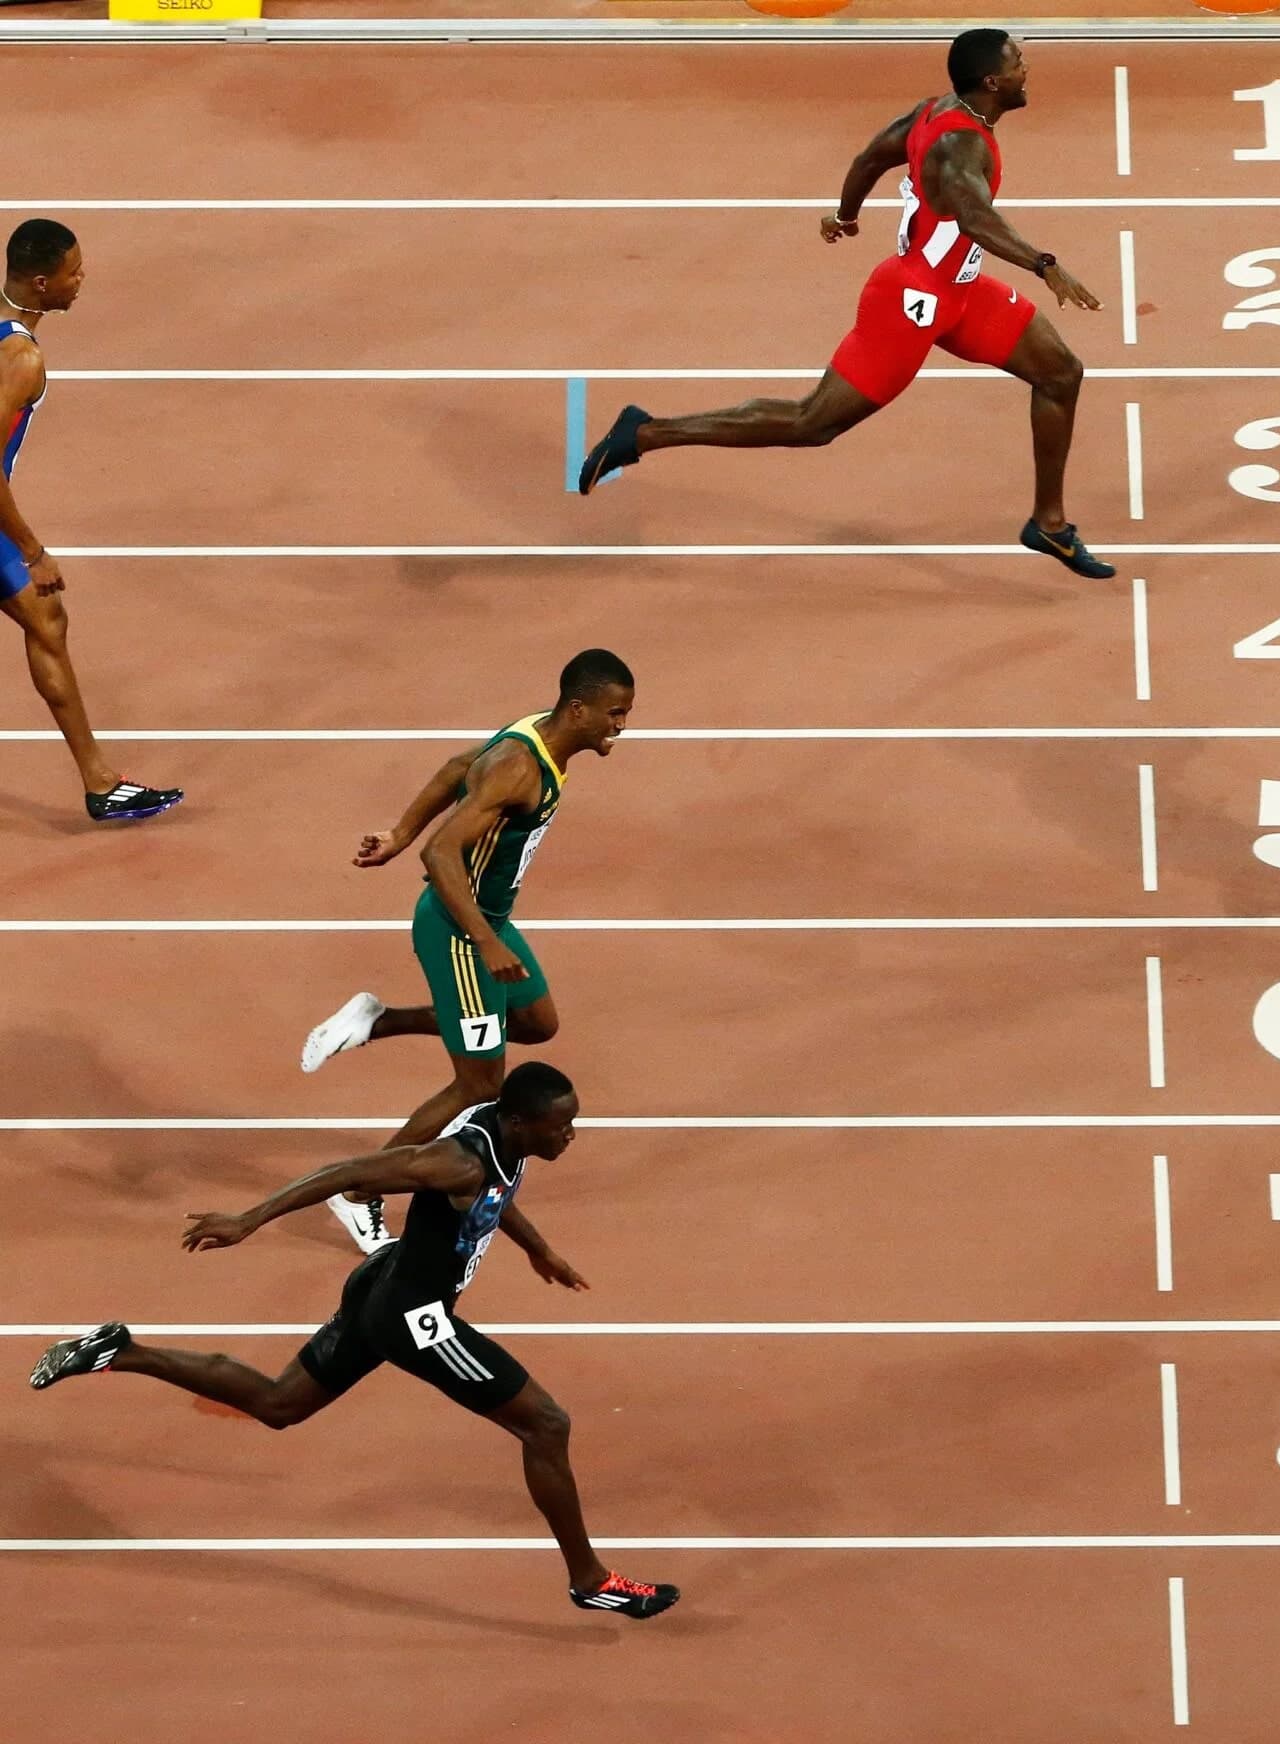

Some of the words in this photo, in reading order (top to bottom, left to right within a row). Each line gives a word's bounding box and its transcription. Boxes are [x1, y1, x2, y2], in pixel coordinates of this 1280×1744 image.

[158, 0, 213, 9] SEIKO
[907, 299, 925, 323] 4
[471, 1023, 489, 1048] 7
[418, 1313, 439, 1341] 9
